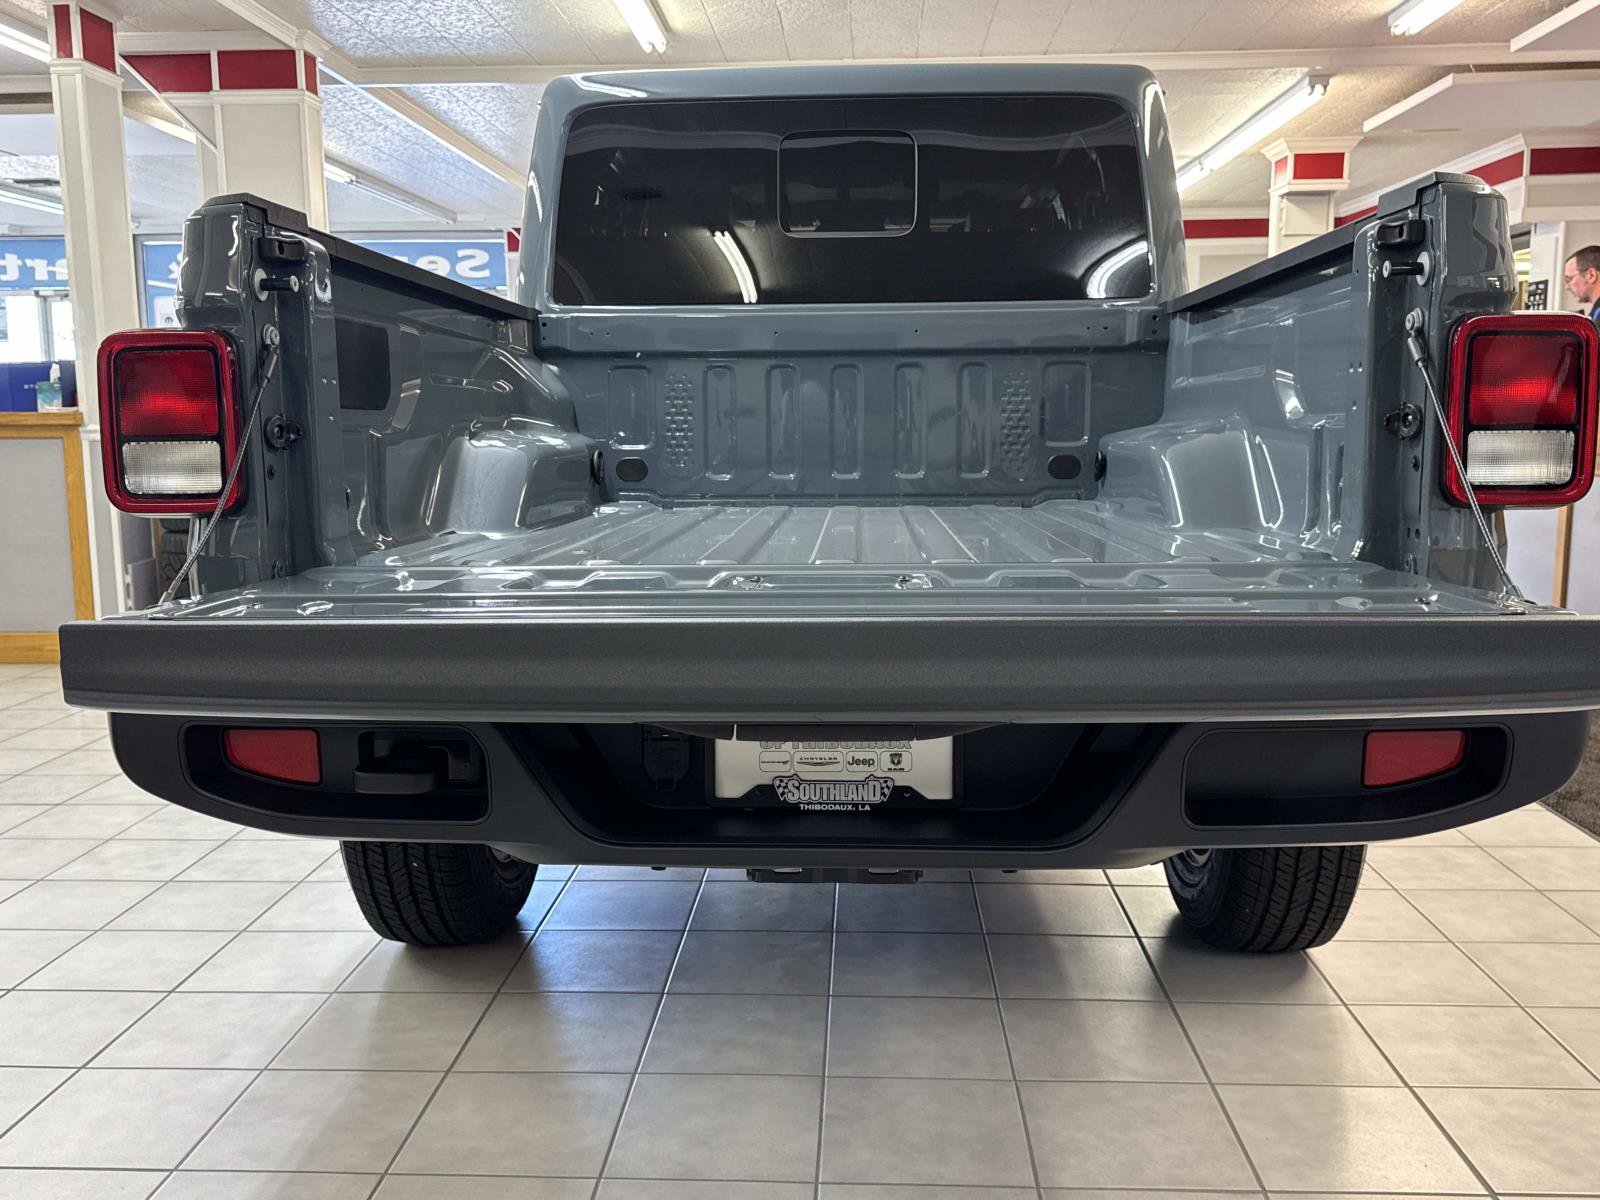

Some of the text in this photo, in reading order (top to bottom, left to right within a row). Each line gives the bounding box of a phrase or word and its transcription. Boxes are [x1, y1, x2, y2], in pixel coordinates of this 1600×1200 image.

[847, 755, 876, 767] Jeep
[787, 778, 881, 801] SOUTHLAND
[858, 803, 871, 811] LA
